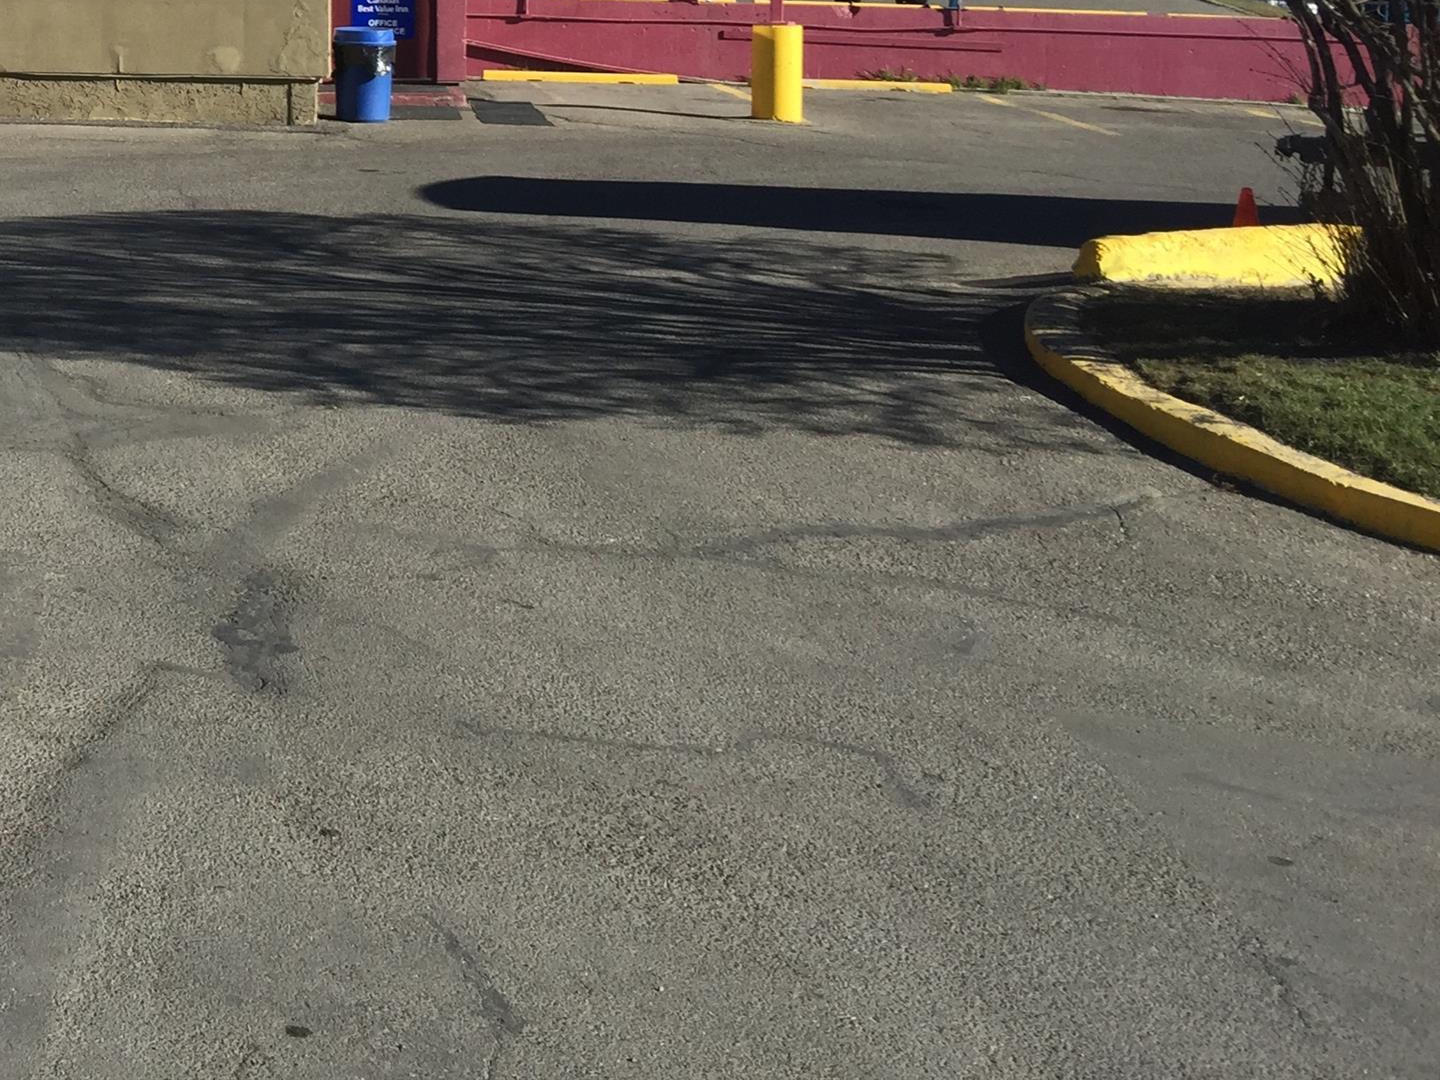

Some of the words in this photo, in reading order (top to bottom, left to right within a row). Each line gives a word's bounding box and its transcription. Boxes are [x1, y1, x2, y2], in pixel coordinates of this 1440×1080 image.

[357, 4, 374, 13] Best
[374, 4, 394, 13] Value
[394, 4, 409, 13] Inn
[368, 19, 398, 27] OFFICE
